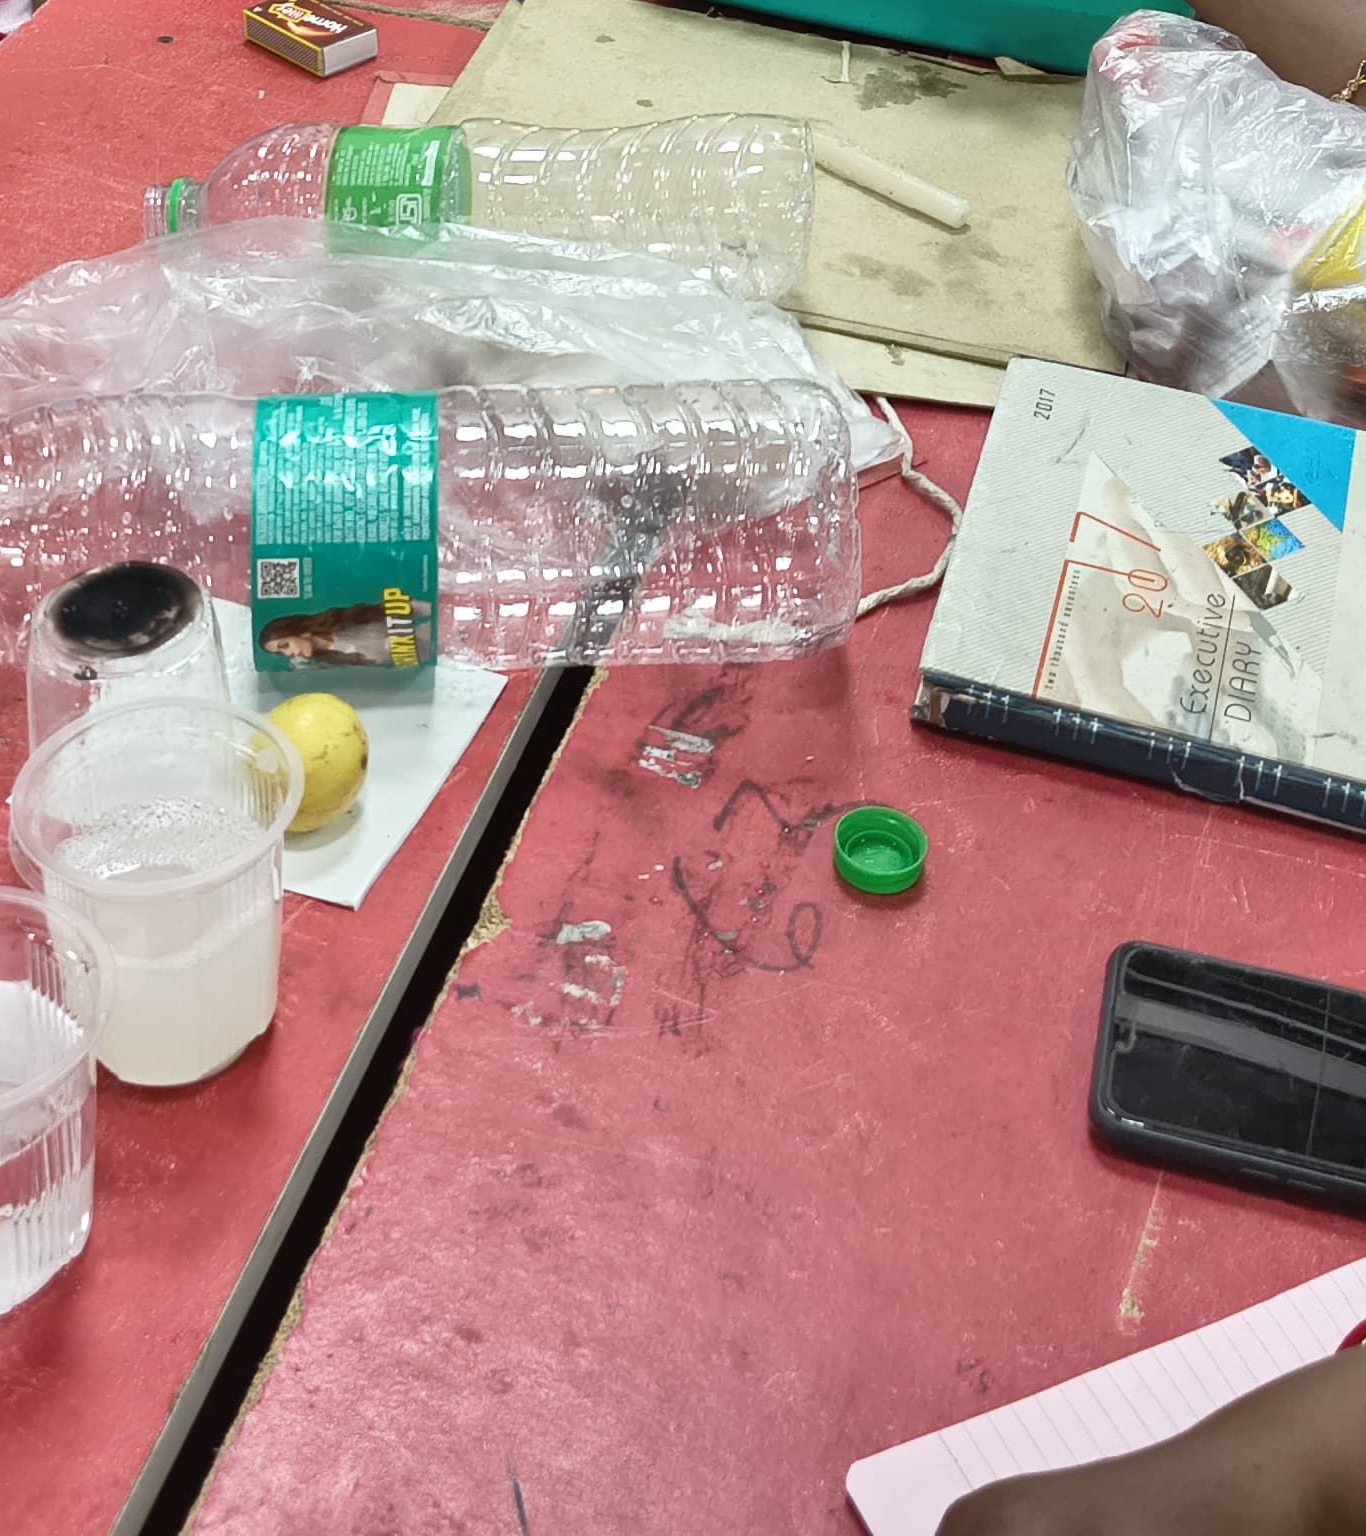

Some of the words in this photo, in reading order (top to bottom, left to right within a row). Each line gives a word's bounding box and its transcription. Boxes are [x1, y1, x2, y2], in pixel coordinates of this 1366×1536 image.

[1033, 387, 1056, 421] 2017
[383, 587, 412, 616] UP
[386, 616, 414, 634] IT
[1179, 592, 1226, 715] Executive
[1223, 640, 1262, 723] DIARY
